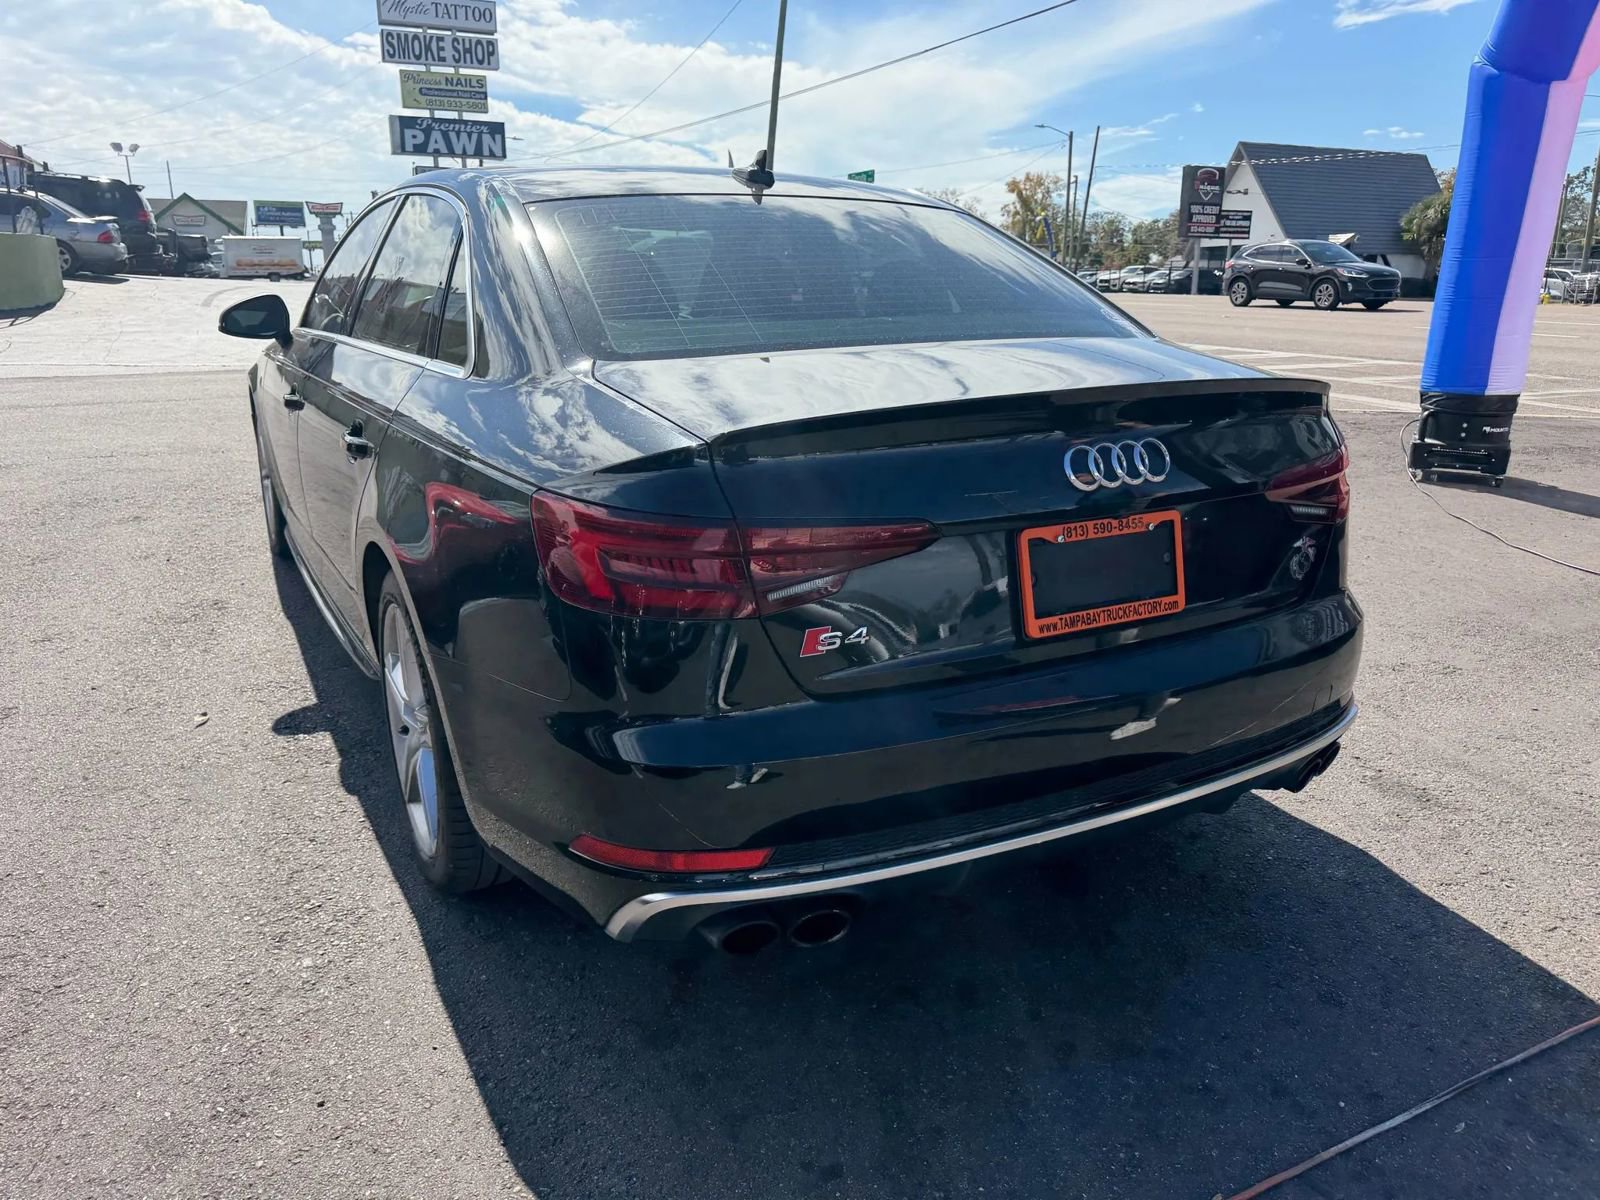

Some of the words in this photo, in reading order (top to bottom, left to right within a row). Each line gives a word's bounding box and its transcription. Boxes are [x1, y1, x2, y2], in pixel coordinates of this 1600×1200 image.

[380, 0, 430, 19] Mystic
[431, 2, 493, 23] TATTOO
[385, 31, 447, 63] SMOKE
[451, 37, 496, 66] SHOP
[445, 76, 484, 89] NAILS
[426, 98, 446, 108] (813)
[416, 118, 490, 133] Premier
[404, 128, 502, 156] PAWN
[1062, 524, 1089, 540] (813)
[1093, 516, 1145, 536] 590-8455
[1038, 599, 1180, 635] www.TAMPABAYTRUCKFACTORY.com
[817, 626, 870, 651] S4
